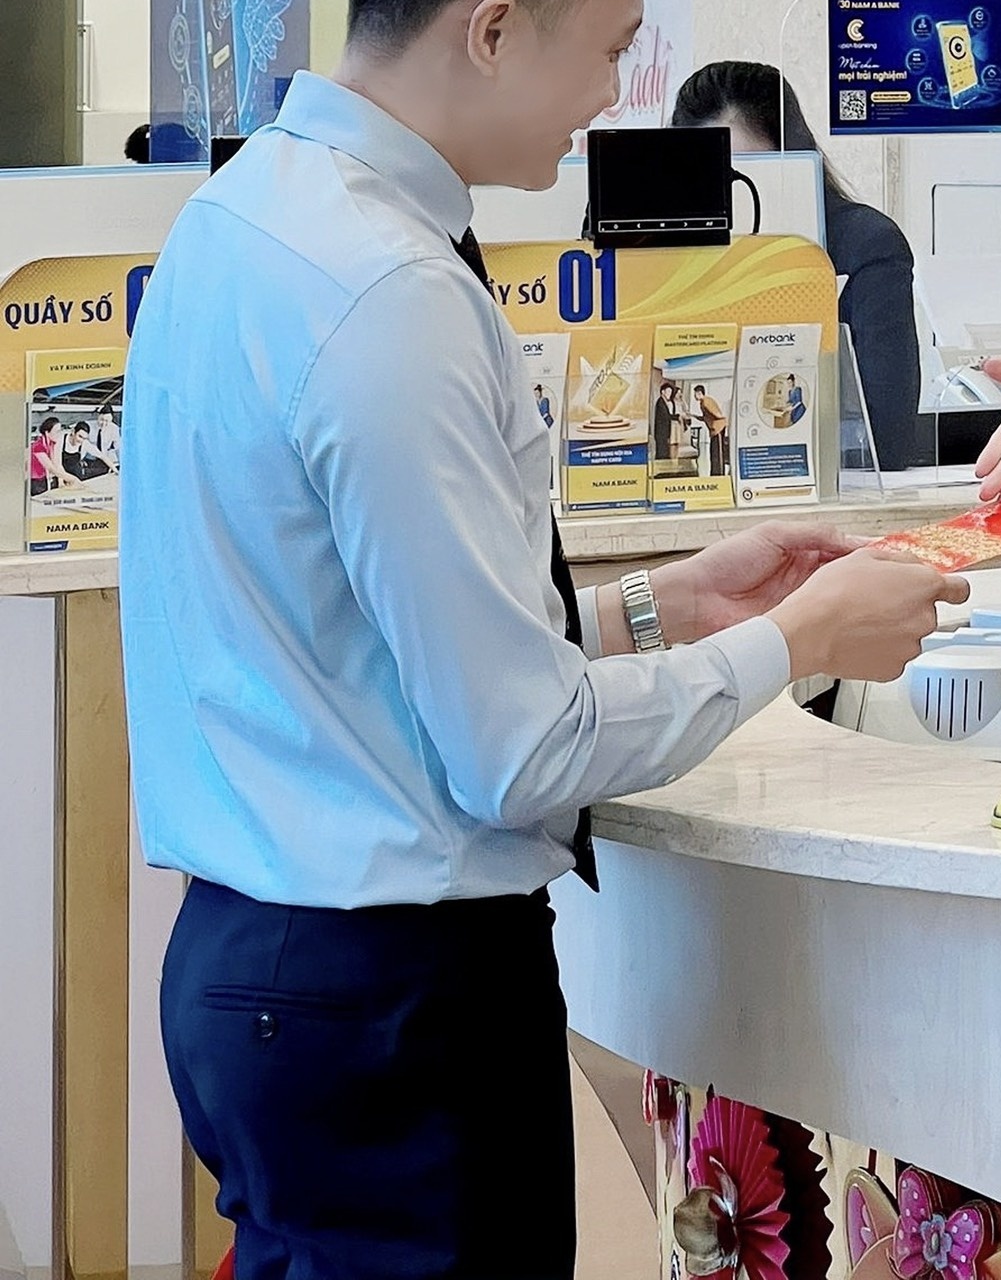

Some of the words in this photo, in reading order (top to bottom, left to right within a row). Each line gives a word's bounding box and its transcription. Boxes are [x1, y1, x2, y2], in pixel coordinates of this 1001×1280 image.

[851, 1, 871, 9] NAM
[871, 1, 878, 9] A
[877, 1, 900, 9] BANK
[518, 275, 547, 304] SỐ
[558, 248, 616, 322] 01
[4, 294, 74, 330] QUẦY
[80, 291, 113, 322] SỐ
[664, 483, 687, 494] NAM
[687, 484, 694, 492] A
[694, 482, 719, 493] BANK
[46, 524, 71, 533] NAM
[72, 523, 80, 531] A
[81, 521, 110, 531] BANK
